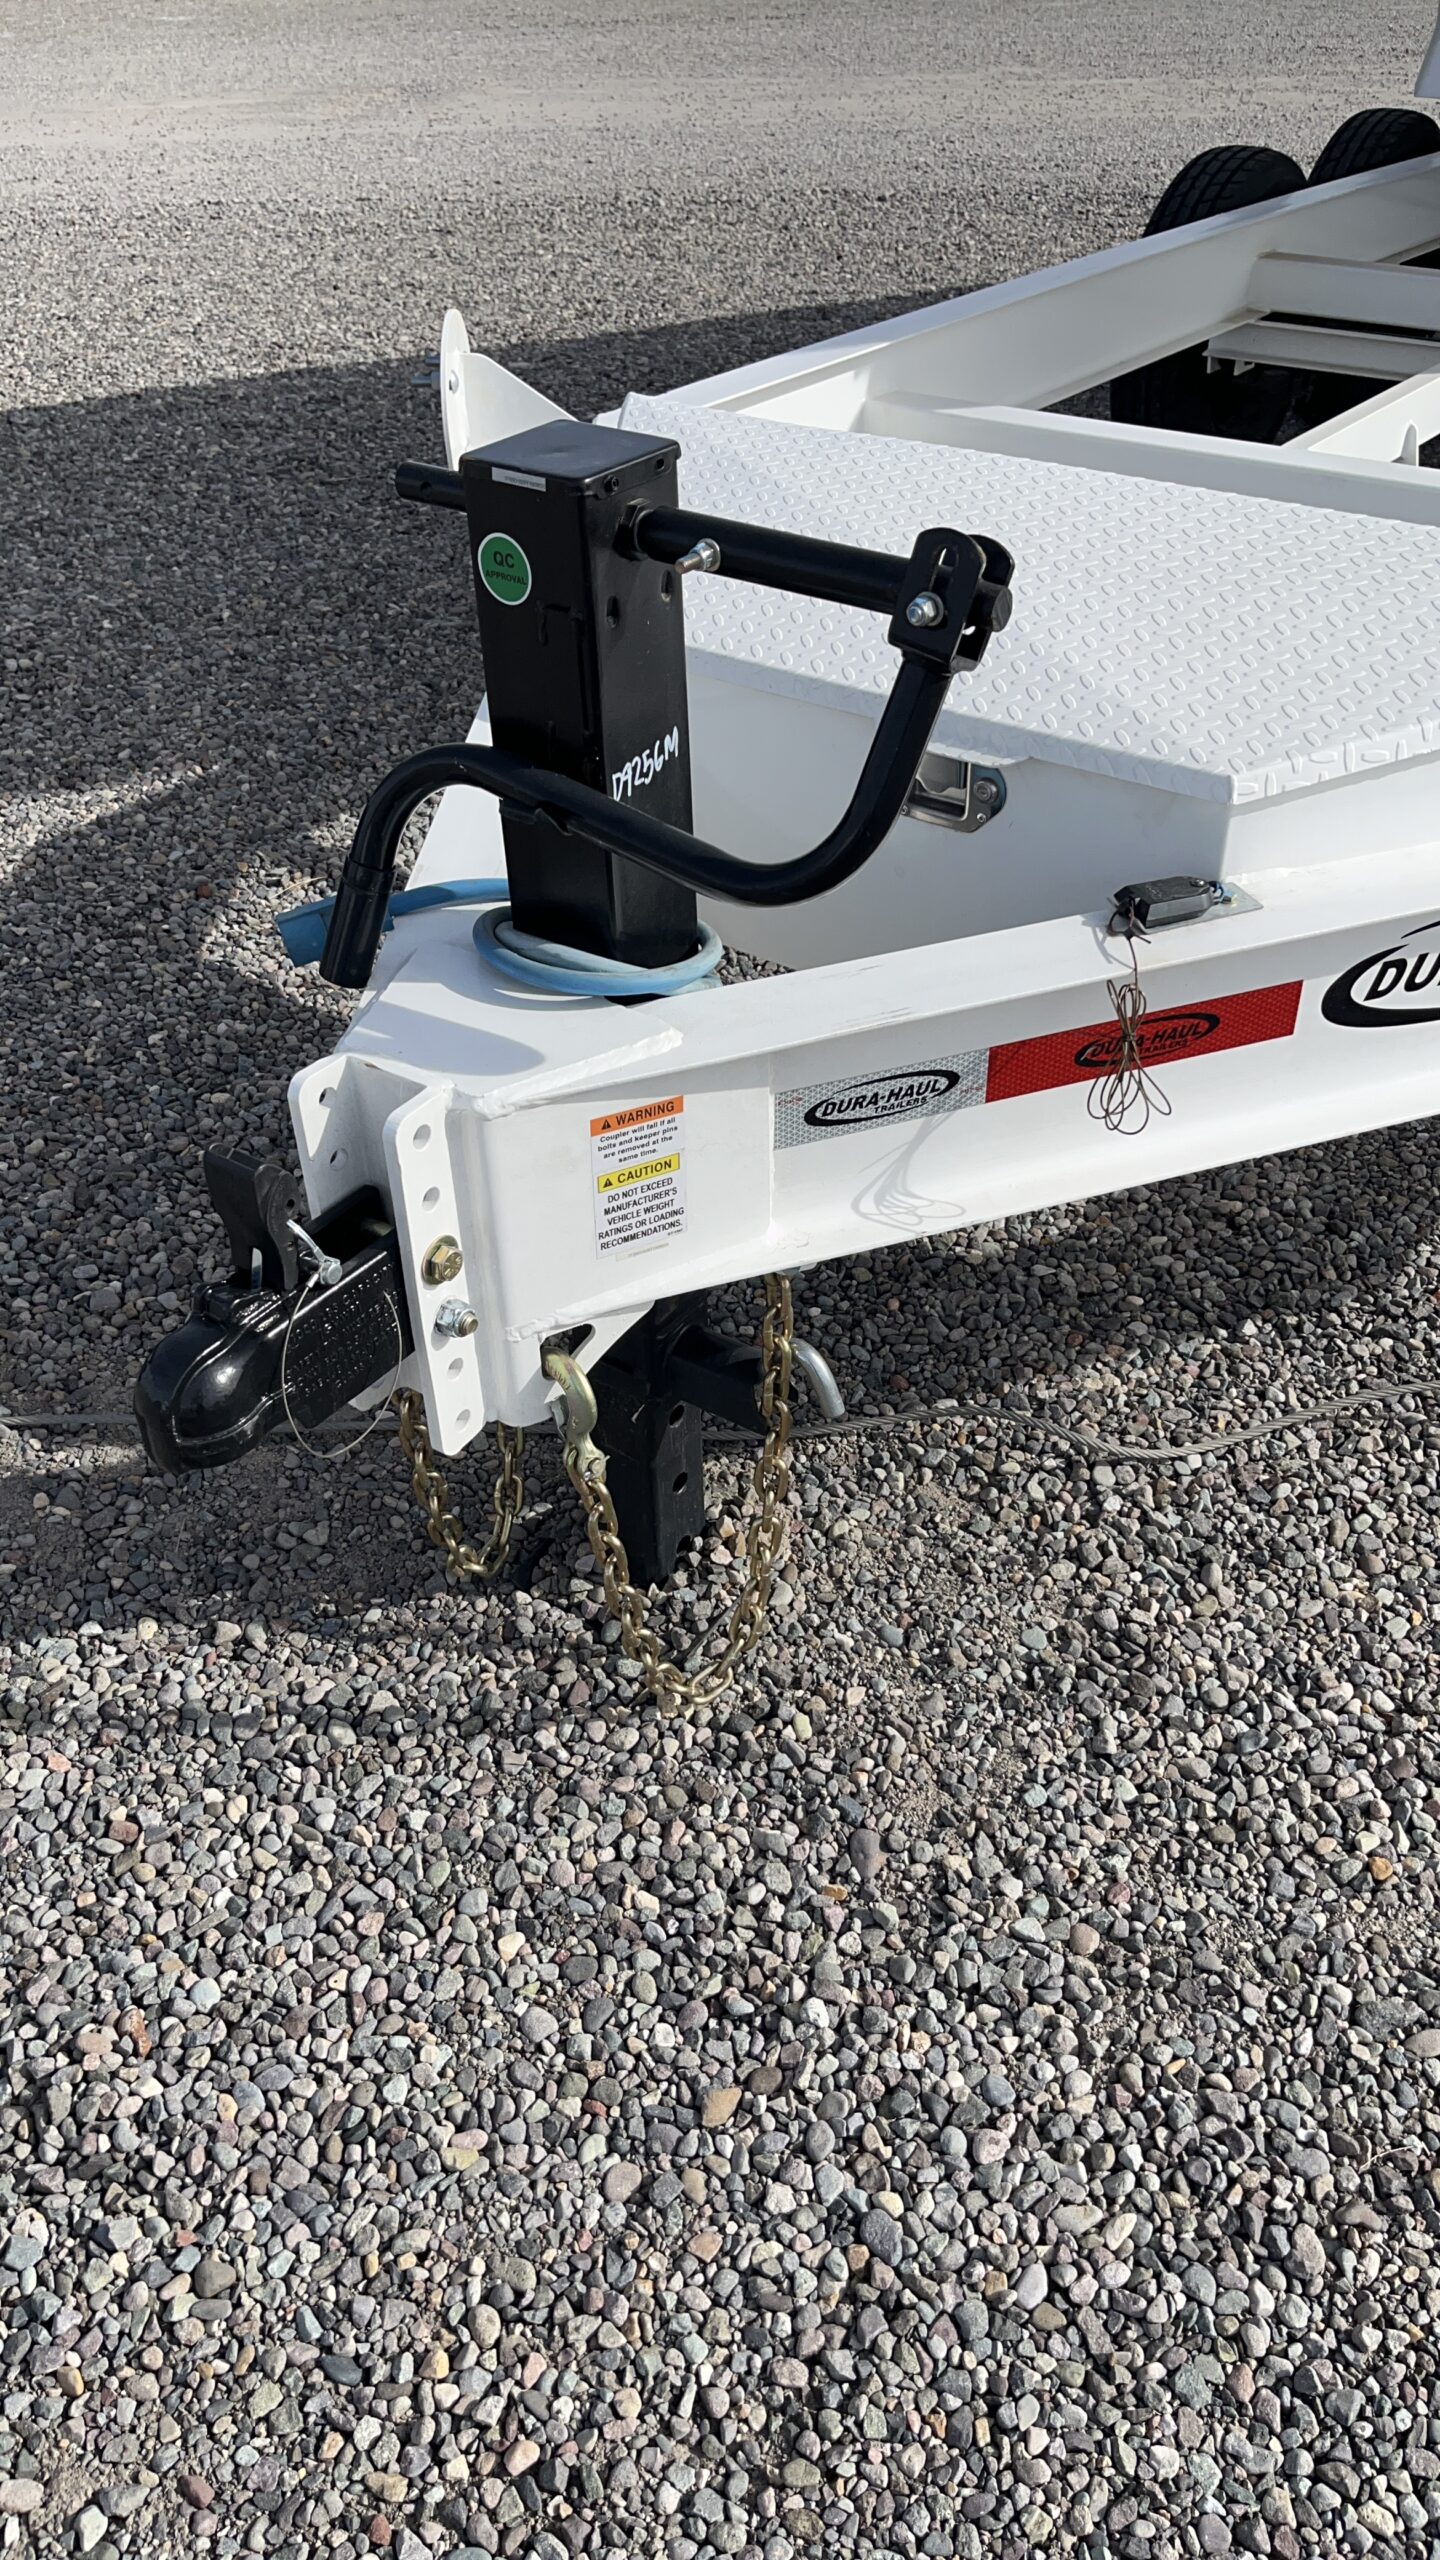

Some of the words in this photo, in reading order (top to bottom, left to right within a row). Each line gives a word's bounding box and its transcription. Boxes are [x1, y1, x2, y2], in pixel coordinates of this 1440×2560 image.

[493, 550, 515, 569] QC
[485, 569, 527, 586] APPROVAL
[612, 725, 679, 801] D9256M
[1363, 952, 1440, 1002] DU
[1091, 1022, 1203, 1058] DUA-HAUL
[821, 1078, 942, 1118] DURA-HAUL
[874, 1096, 928, 1114] TRAILERS
[616, 1101, 675, 1126] WARNING
[597, 1142, 617, 1152] bolts
[619, 1137, 633, 1146] and
[635, 1130, 660, 1142] keeper
[662, 1126, 678, 1136] pins
[600, 1130, 629, 1143] Coupler
[632, 1125, 645, 1134] will
[667, 1117, 676, 1125] all
[603, 1151, 616, 1159] are
[617, 1142, 650, 1155] removed
[661, 1135, 673, 1143] the
[619, 1153, 639, 1163] same
[640, 1148, 658, 1157] time.
[617, 1159, 672, 1184] CAUTION
[604, 1187, 678, 1216] MANUFACTURER'S
[607, 1193, 620, 1203] DO
[622, 1187, 639, 1199] NOT
[640, 1177, 673, 1194] EXCEED
[598, 1223, 633, 1240] RATINGS
[635, 1219, 647, 1229] OR
[649, 1206, 685, 1225] LOADING
[607, 1209, 641, 1226] VEHICLE
[643, 1199, 675, 1215] WEIGHT
[600, 1219, 683, 1251] RECOMMENDATIONS.
